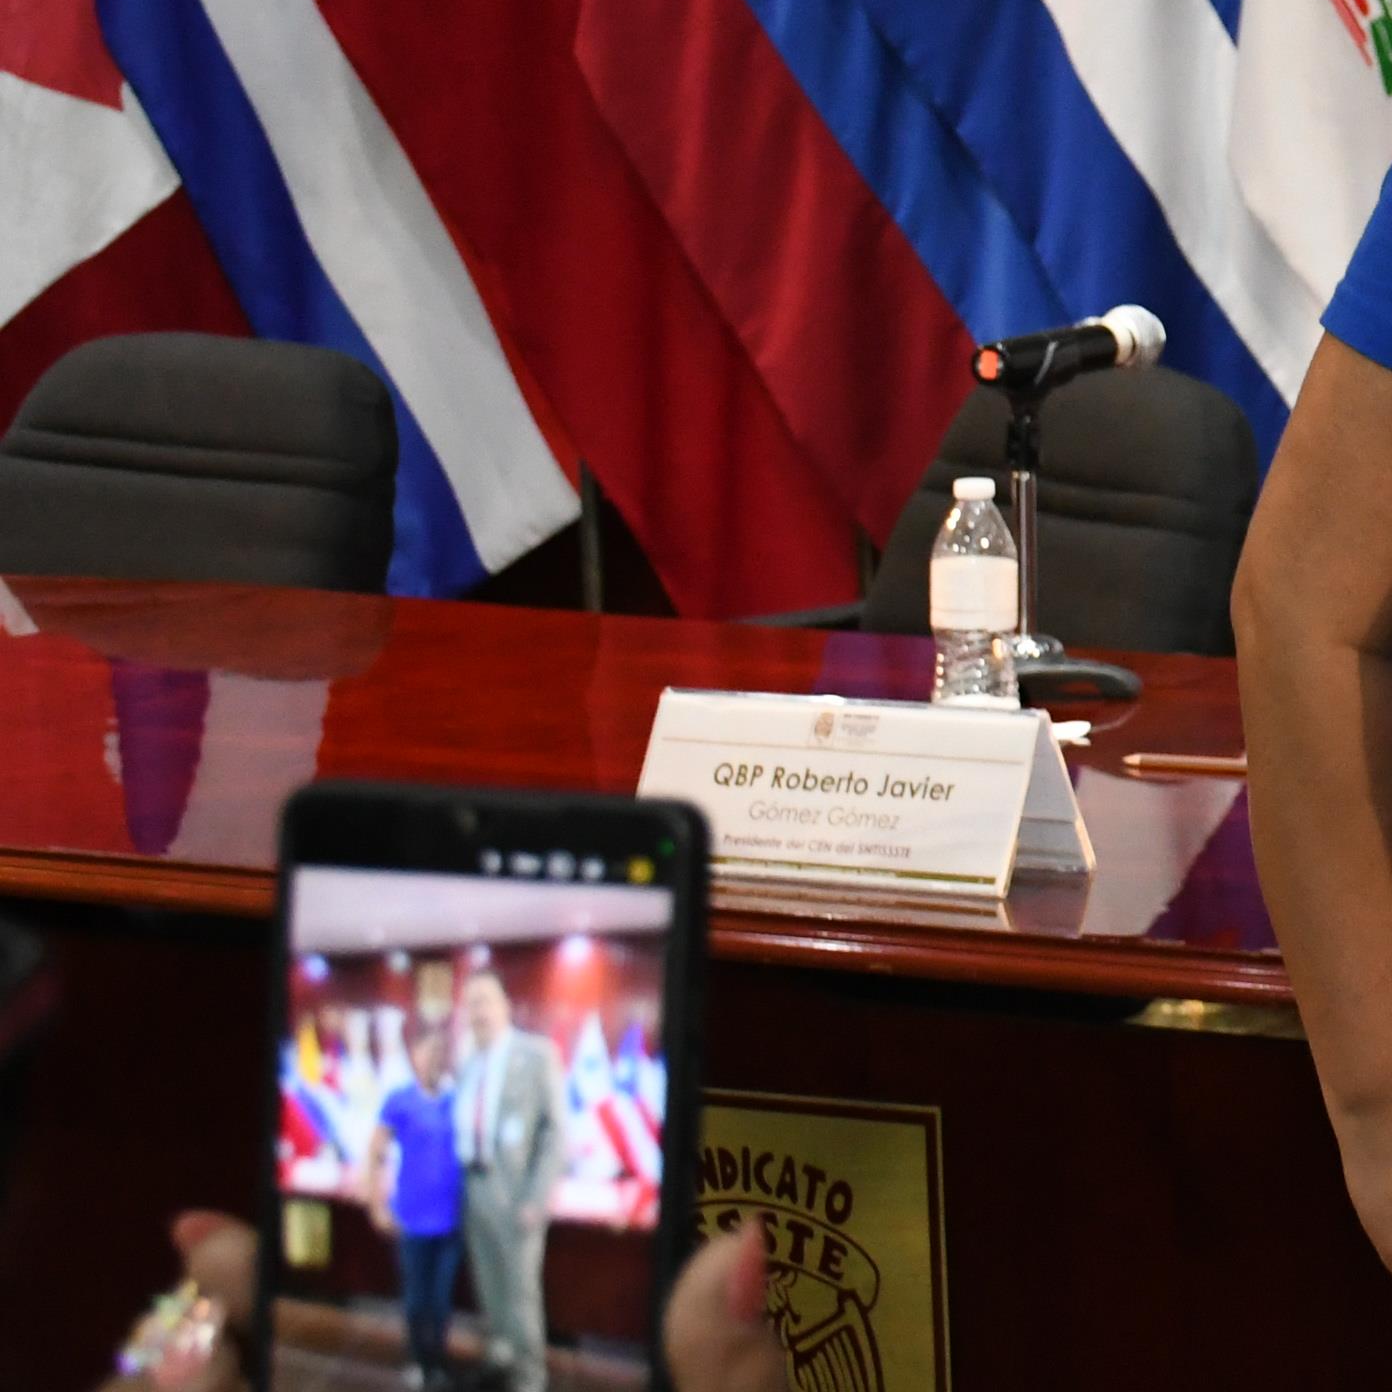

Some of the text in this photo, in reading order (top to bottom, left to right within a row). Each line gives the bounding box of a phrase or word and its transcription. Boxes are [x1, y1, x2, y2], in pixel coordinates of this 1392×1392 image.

[713, 762, 956, 802] QBP Roberto Javier
[748, 799, 901, 831] Gómez Gómez
[723, 834, 782, 849] Presidente
[697, 1145, 853, 1225] NDICATO
